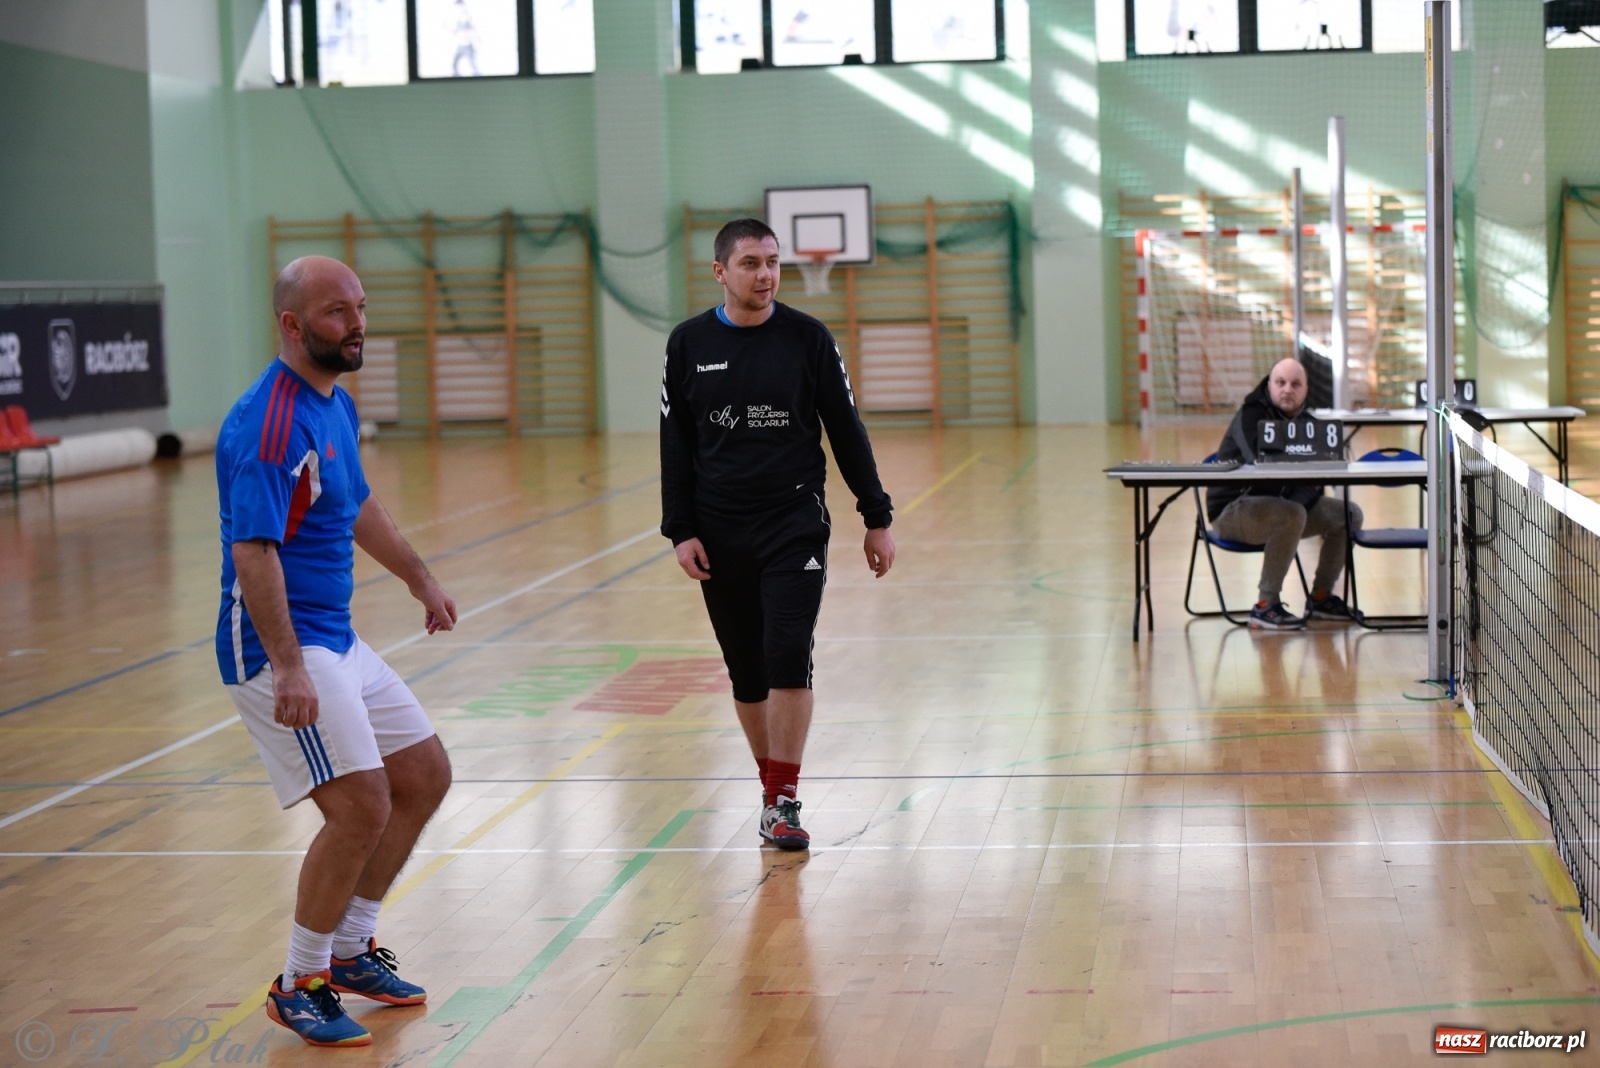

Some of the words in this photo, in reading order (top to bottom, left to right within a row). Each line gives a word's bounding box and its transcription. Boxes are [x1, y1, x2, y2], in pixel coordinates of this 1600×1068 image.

[696, 360, 728, 373] hummel
[747, 404, 772, 412] SALON
[747, 411, 789, 419] FRYZJERSKI
[747, 419, 790, 428] SOLARIUM
[1263, 422, 1276, 443] 5
[1287, 422, 1296, 439] 0
[1305, 422, 1315, 439] 0
[1326, 423, 1338, 448] 8
[1285, 444, 1313, 453] JOOLA
